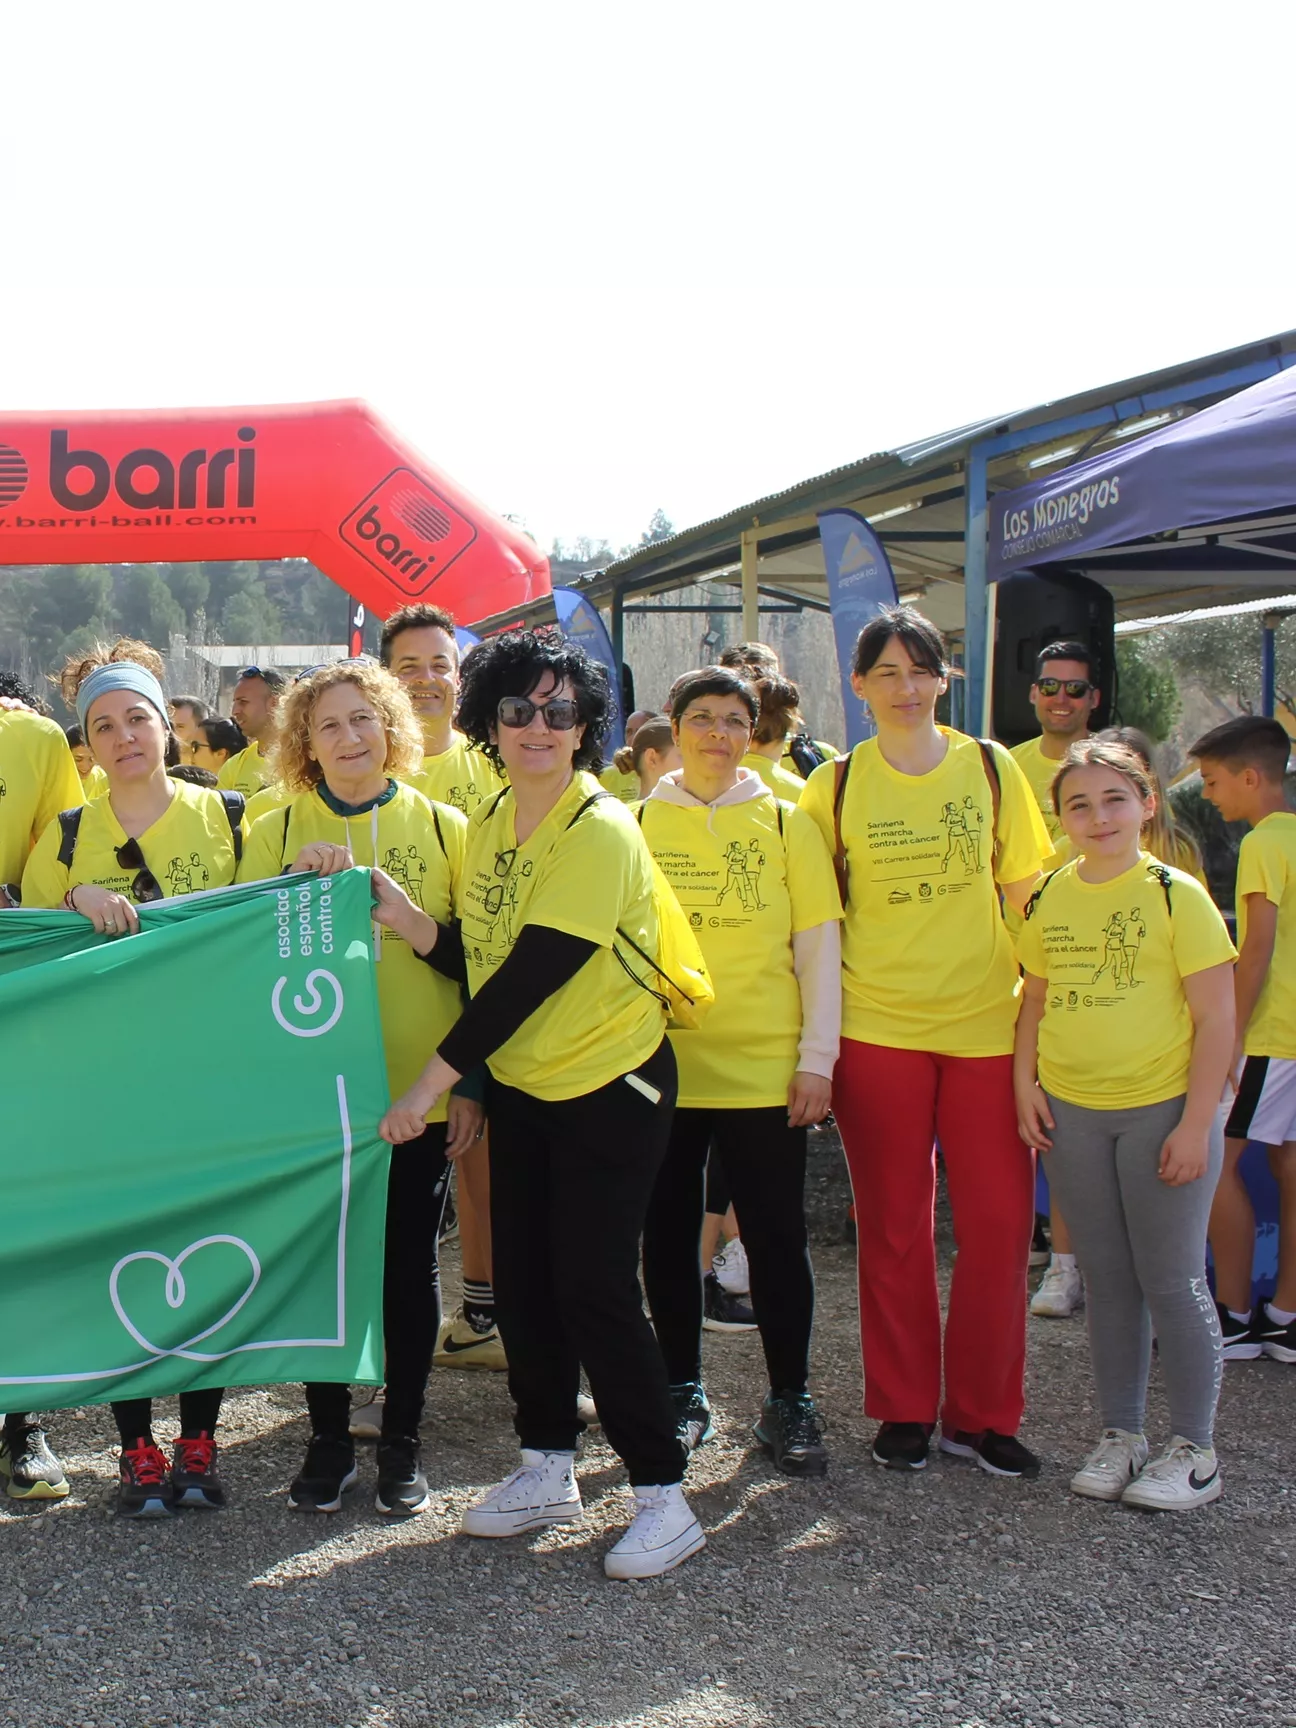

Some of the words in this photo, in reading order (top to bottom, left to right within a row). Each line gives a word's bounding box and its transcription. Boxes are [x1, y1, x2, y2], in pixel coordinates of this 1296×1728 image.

[48, 426, 258, 512] barri
[1003, 510, 1029, 540] Los
[1033, 476, 1120, 524] Monegros
[356, 504, 436, 582] barri
[867, 820, 905, 829] Sariñena
[880, 829, 913, 838] marcha
[869, 838, 898, 849] contra
[909, 835, 940, 844] cáncer
[884, 856, 910, 864] Carrera
[911, 852, 941, 861] solidaria
[105, 884, 133, 892] march
[317, 895, 334, 954] contra
